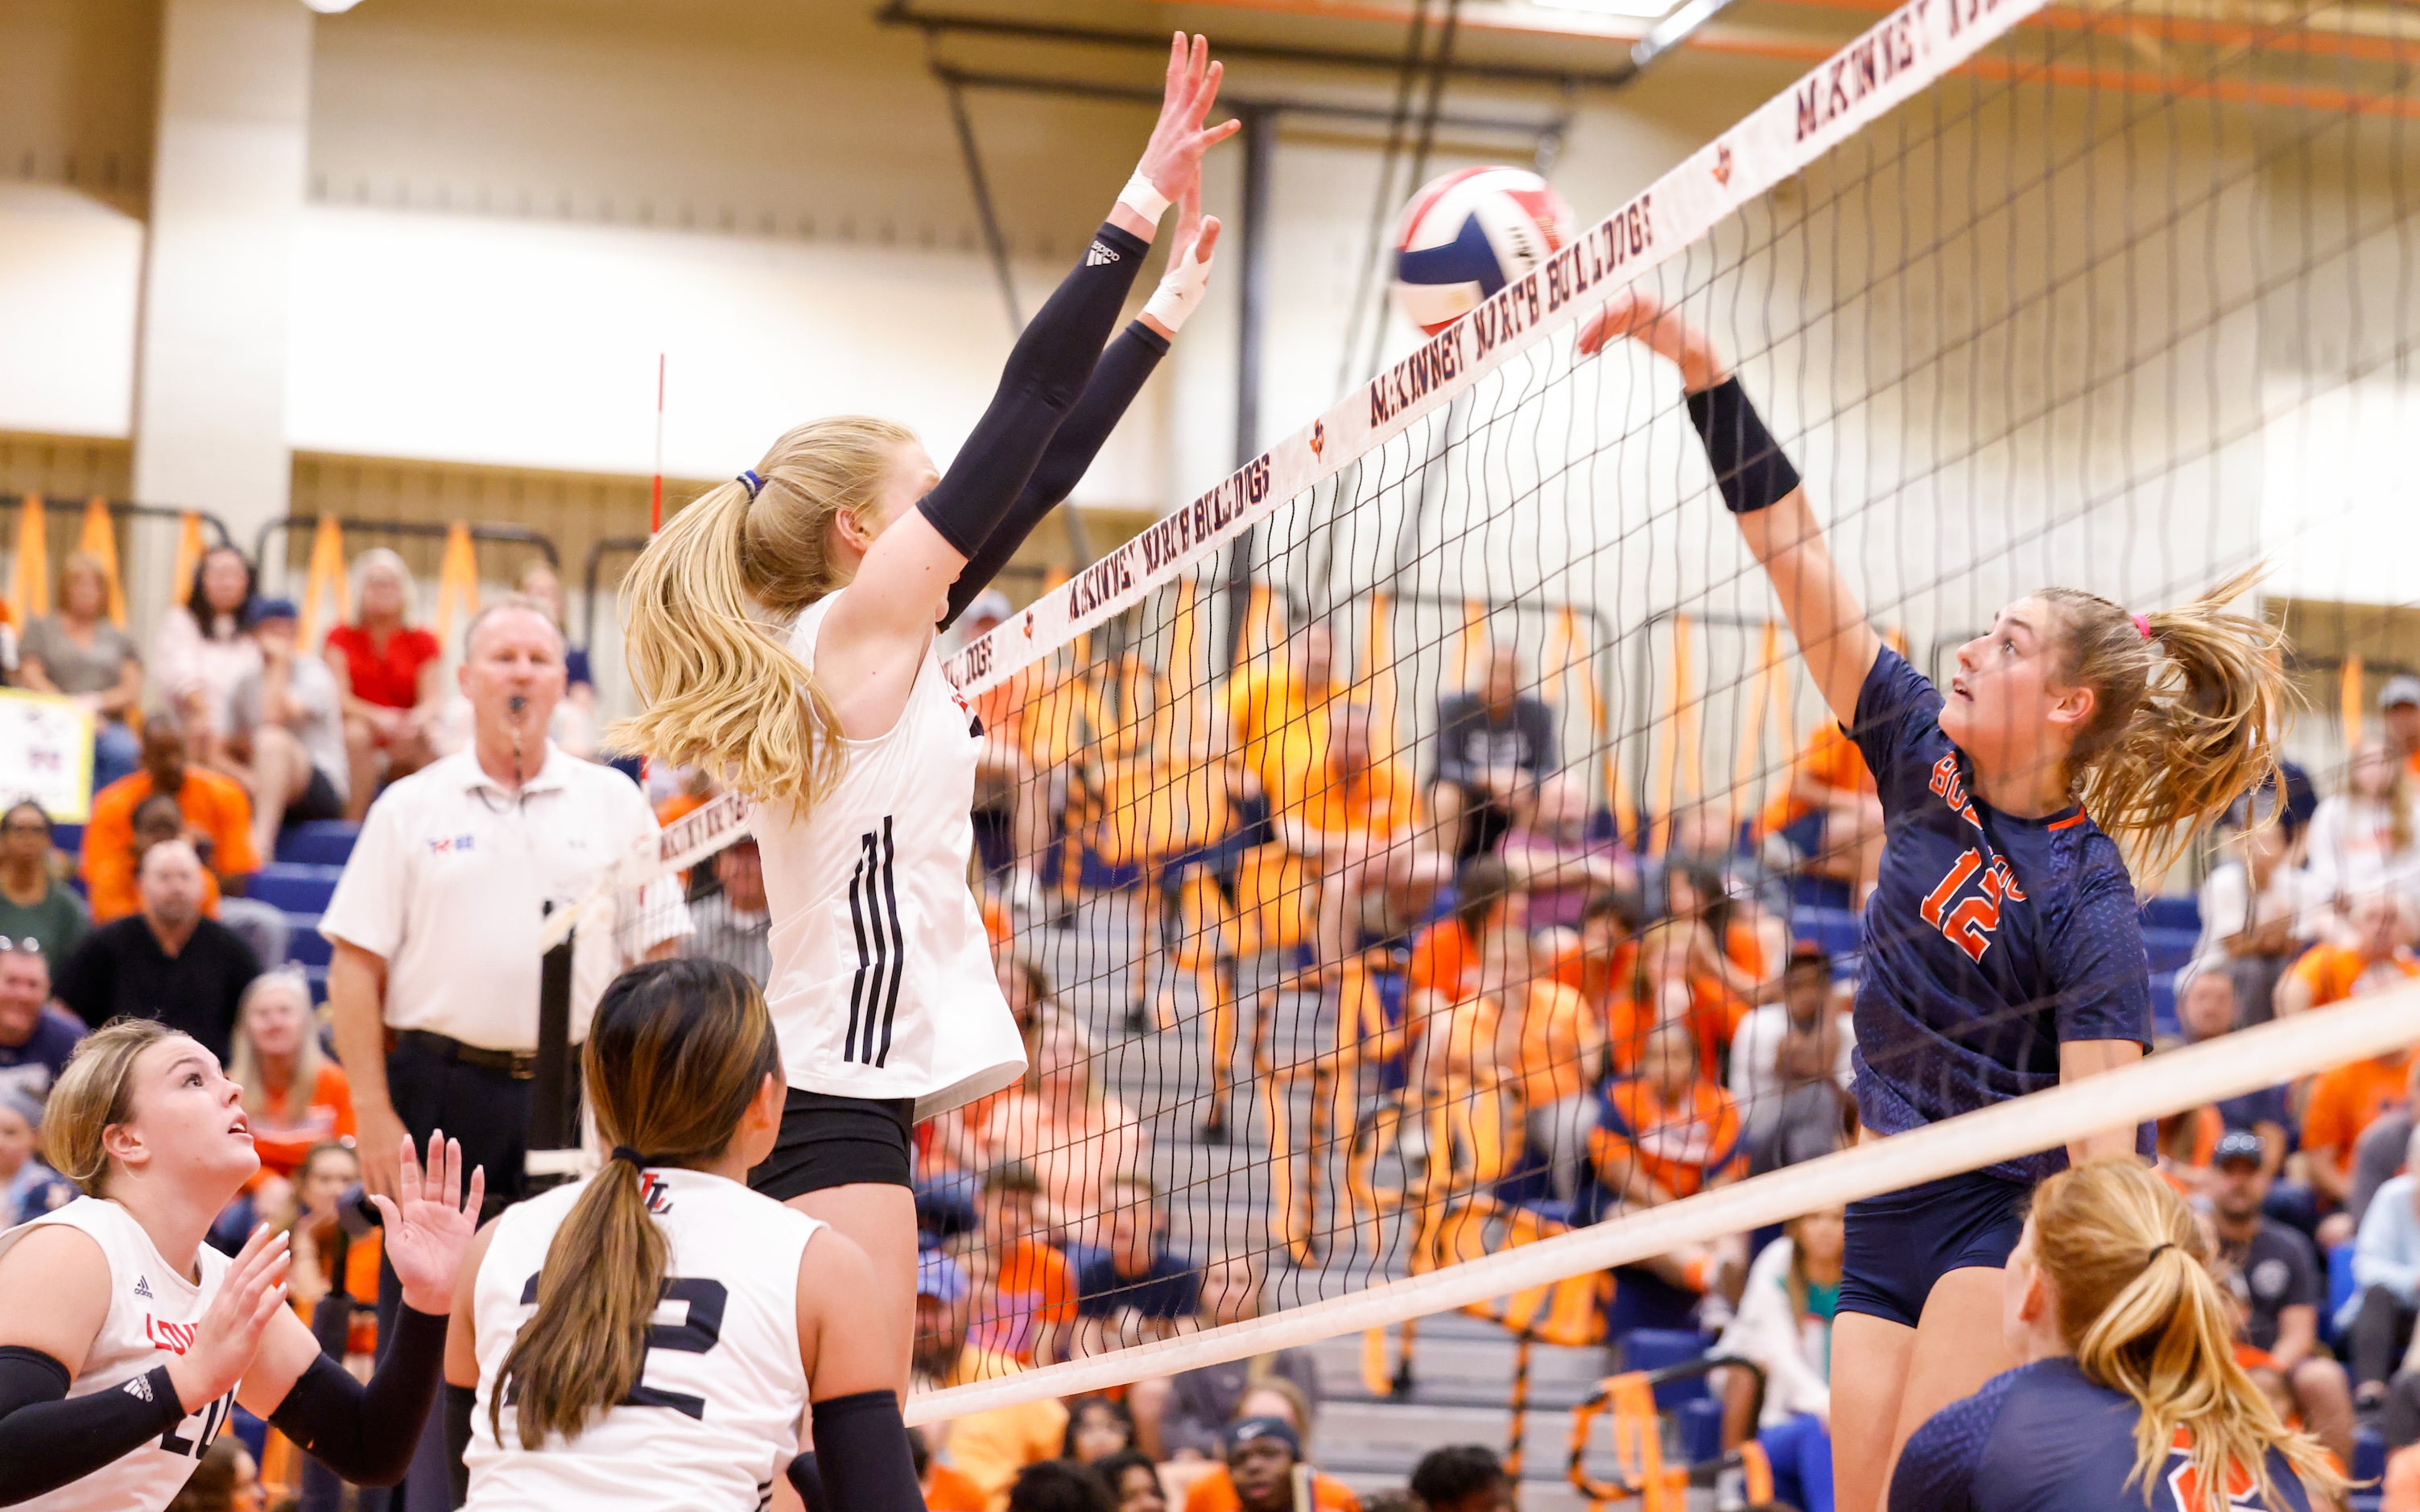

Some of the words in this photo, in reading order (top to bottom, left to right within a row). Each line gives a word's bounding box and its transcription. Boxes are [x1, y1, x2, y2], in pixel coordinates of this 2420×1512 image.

[1547, 193, 1654, 312] BULLDOGS
[1194, 452, 1270, 545] BULLDOGS
[1920, 847, 2003, 965] 12
[146, 1313, 199, 1356] LOV
